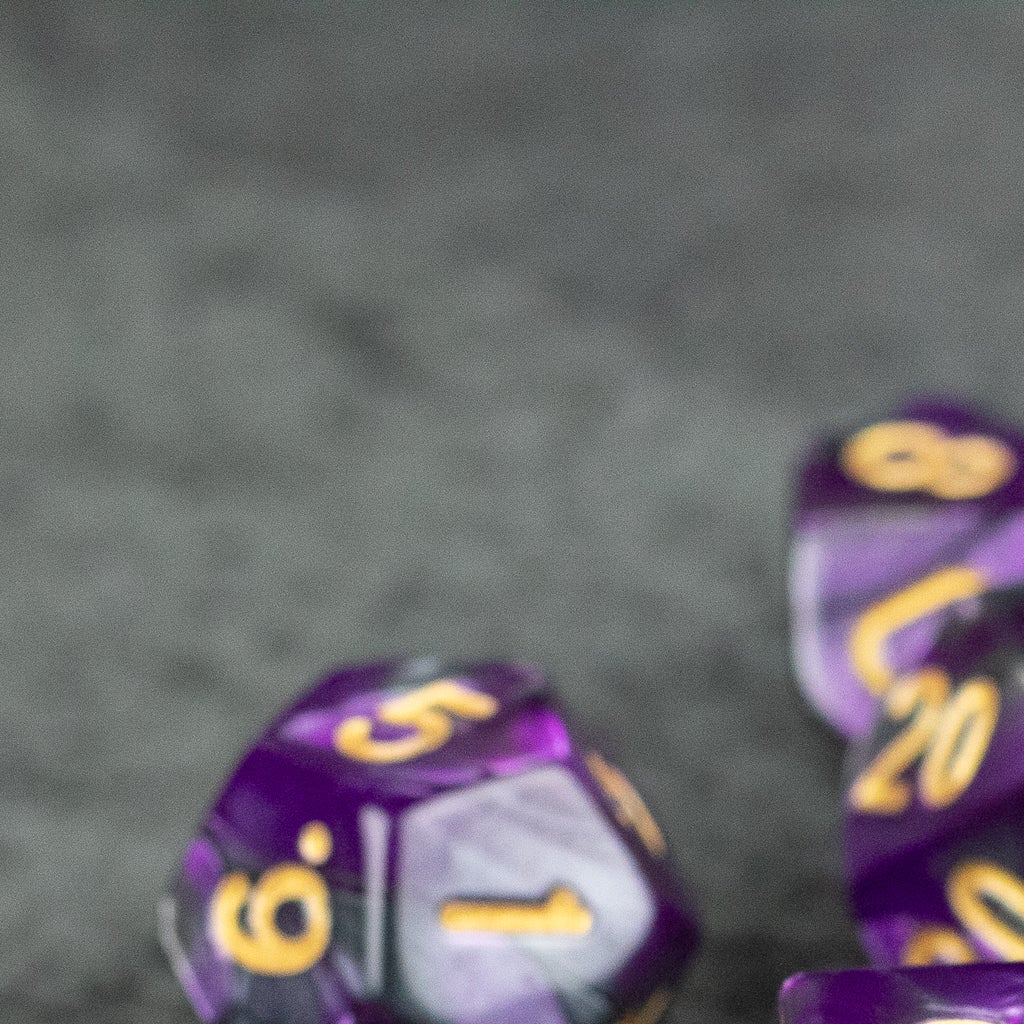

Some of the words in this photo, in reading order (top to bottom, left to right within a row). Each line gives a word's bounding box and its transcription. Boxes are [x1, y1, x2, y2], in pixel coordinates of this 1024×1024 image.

[842, 422, 1008, 500] 8
[335, 678, 500, 764] 5
[850, 668, 1000, 814] 20
[440, 886, 592, 936] 1
